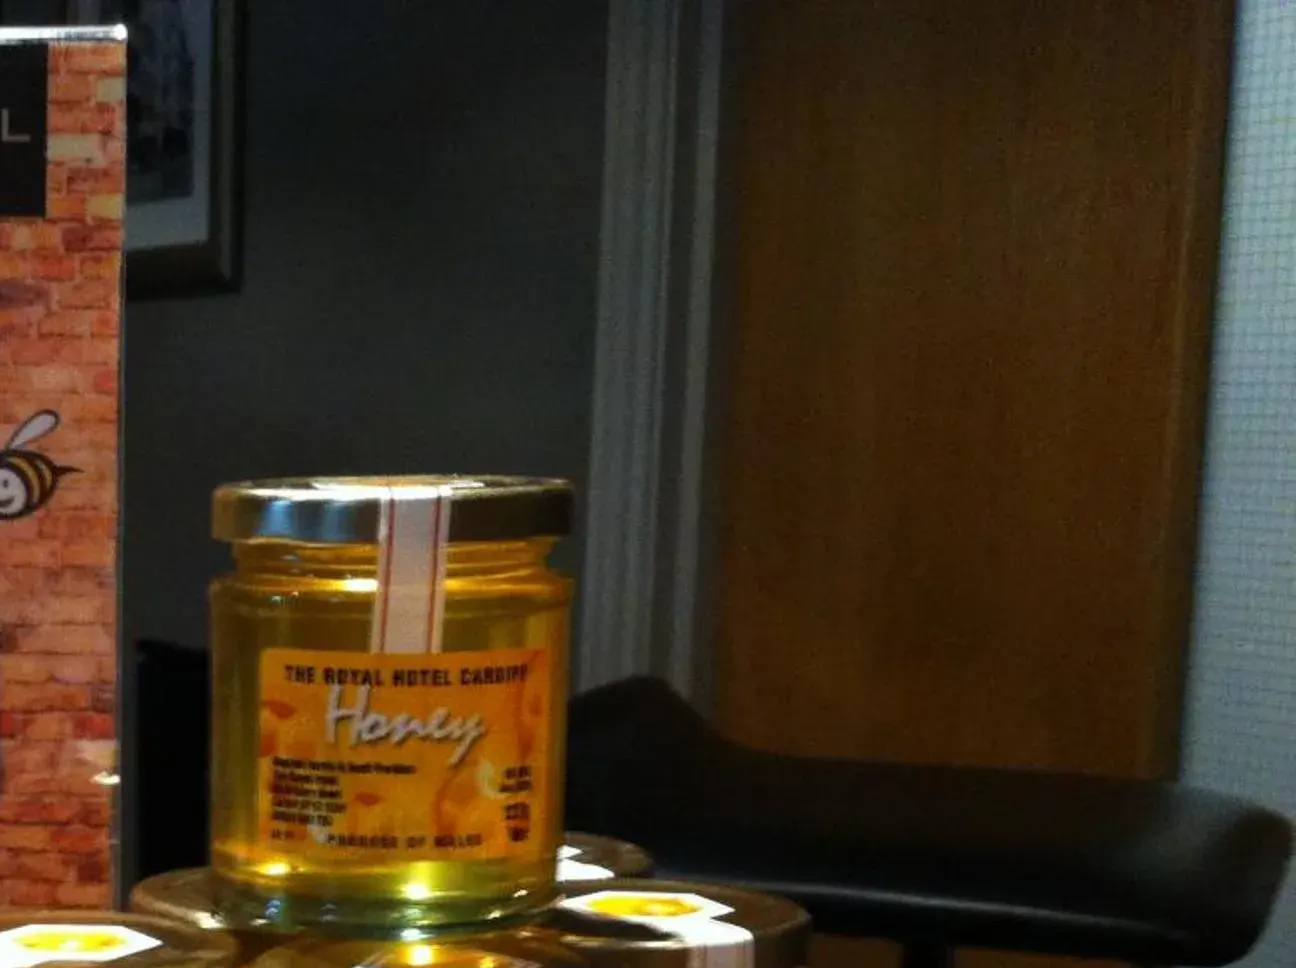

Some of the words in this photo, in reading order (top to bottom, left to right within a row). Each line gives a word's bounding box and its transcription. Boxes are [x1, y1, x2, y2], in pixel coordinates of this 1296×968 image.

[284, 664, 316, 685] THE
[323, 666, 386, 688] ROYAL
[391, 667, 453, 688] HOTEL
[459, 663, 529, 688] CARDIFF
[324, 681, 490, 768] Honey
